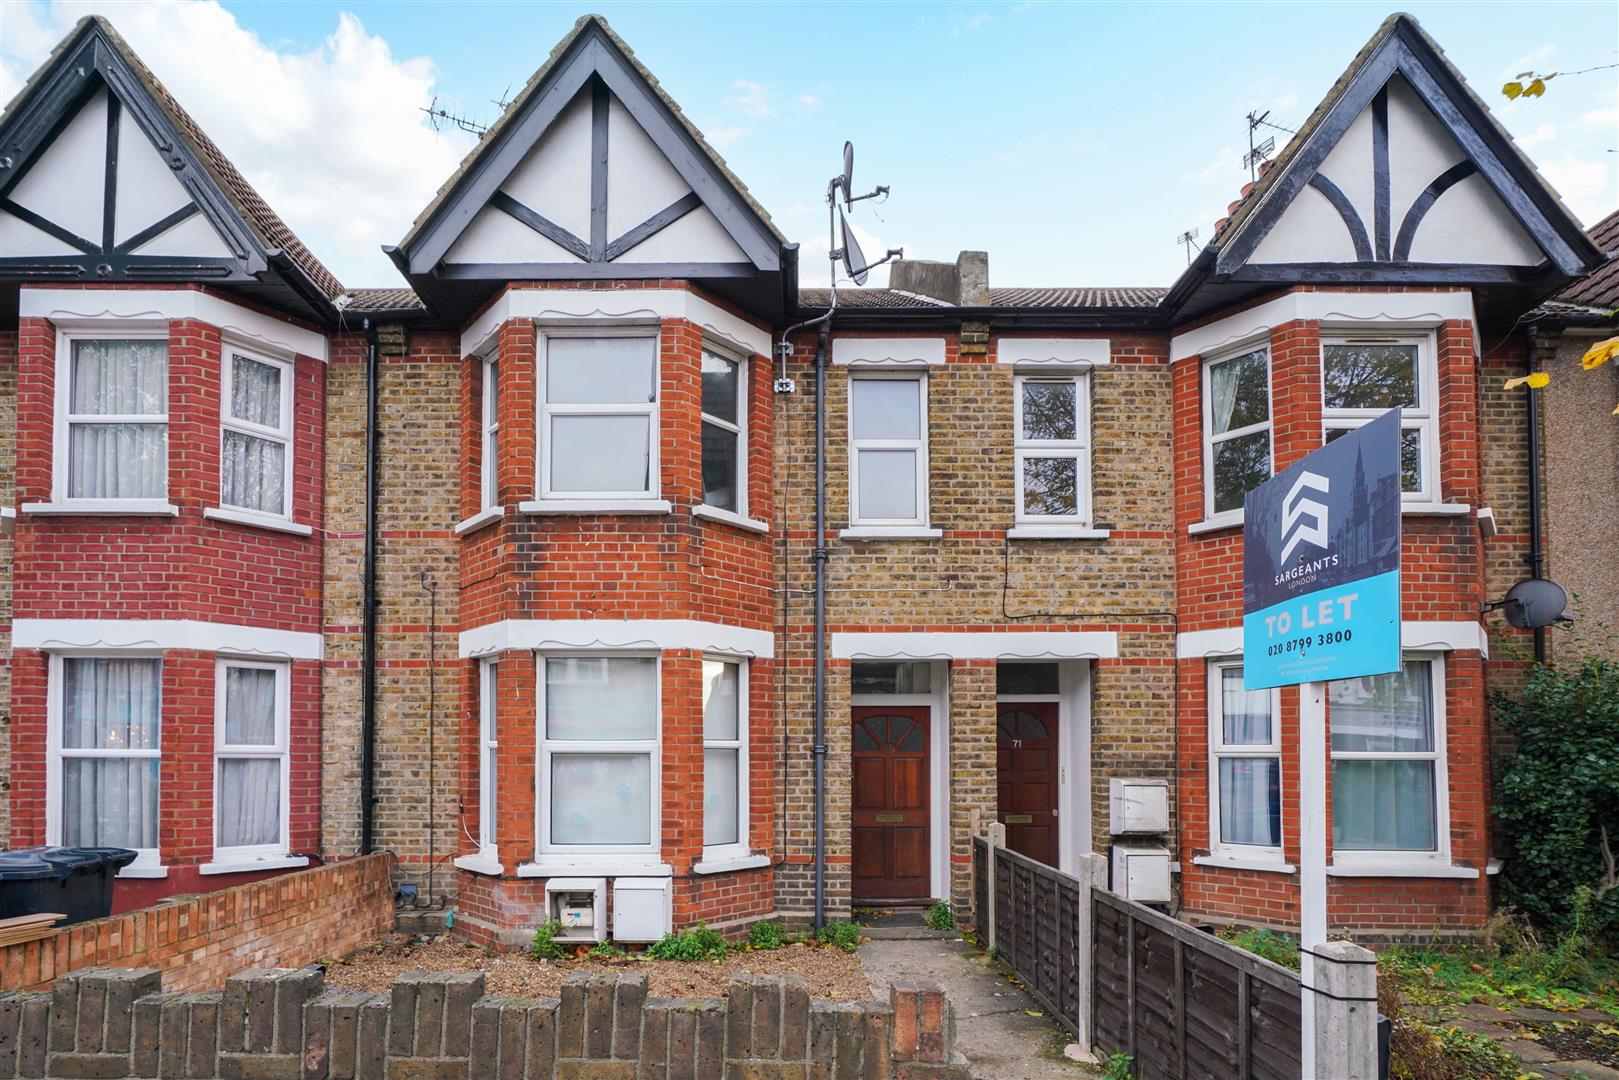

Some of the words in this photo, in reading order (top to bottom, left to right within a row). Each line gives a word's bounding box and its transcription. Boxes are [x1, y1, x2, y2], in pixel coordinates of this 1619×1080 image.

[1274, 554, 1339, 586] SARGEANTS
[1288, 574, 1317, 590] LONDON
[1265, 611, 1292, 639] TO
[1302, 593, 1359, 629] LET
[1268, 643, 1283, 657] 020
[1286, 636, 1312, 653] 8799
[1318, 629, 1352, 646] 3800
[1012, 739, 1022, 748] 71
